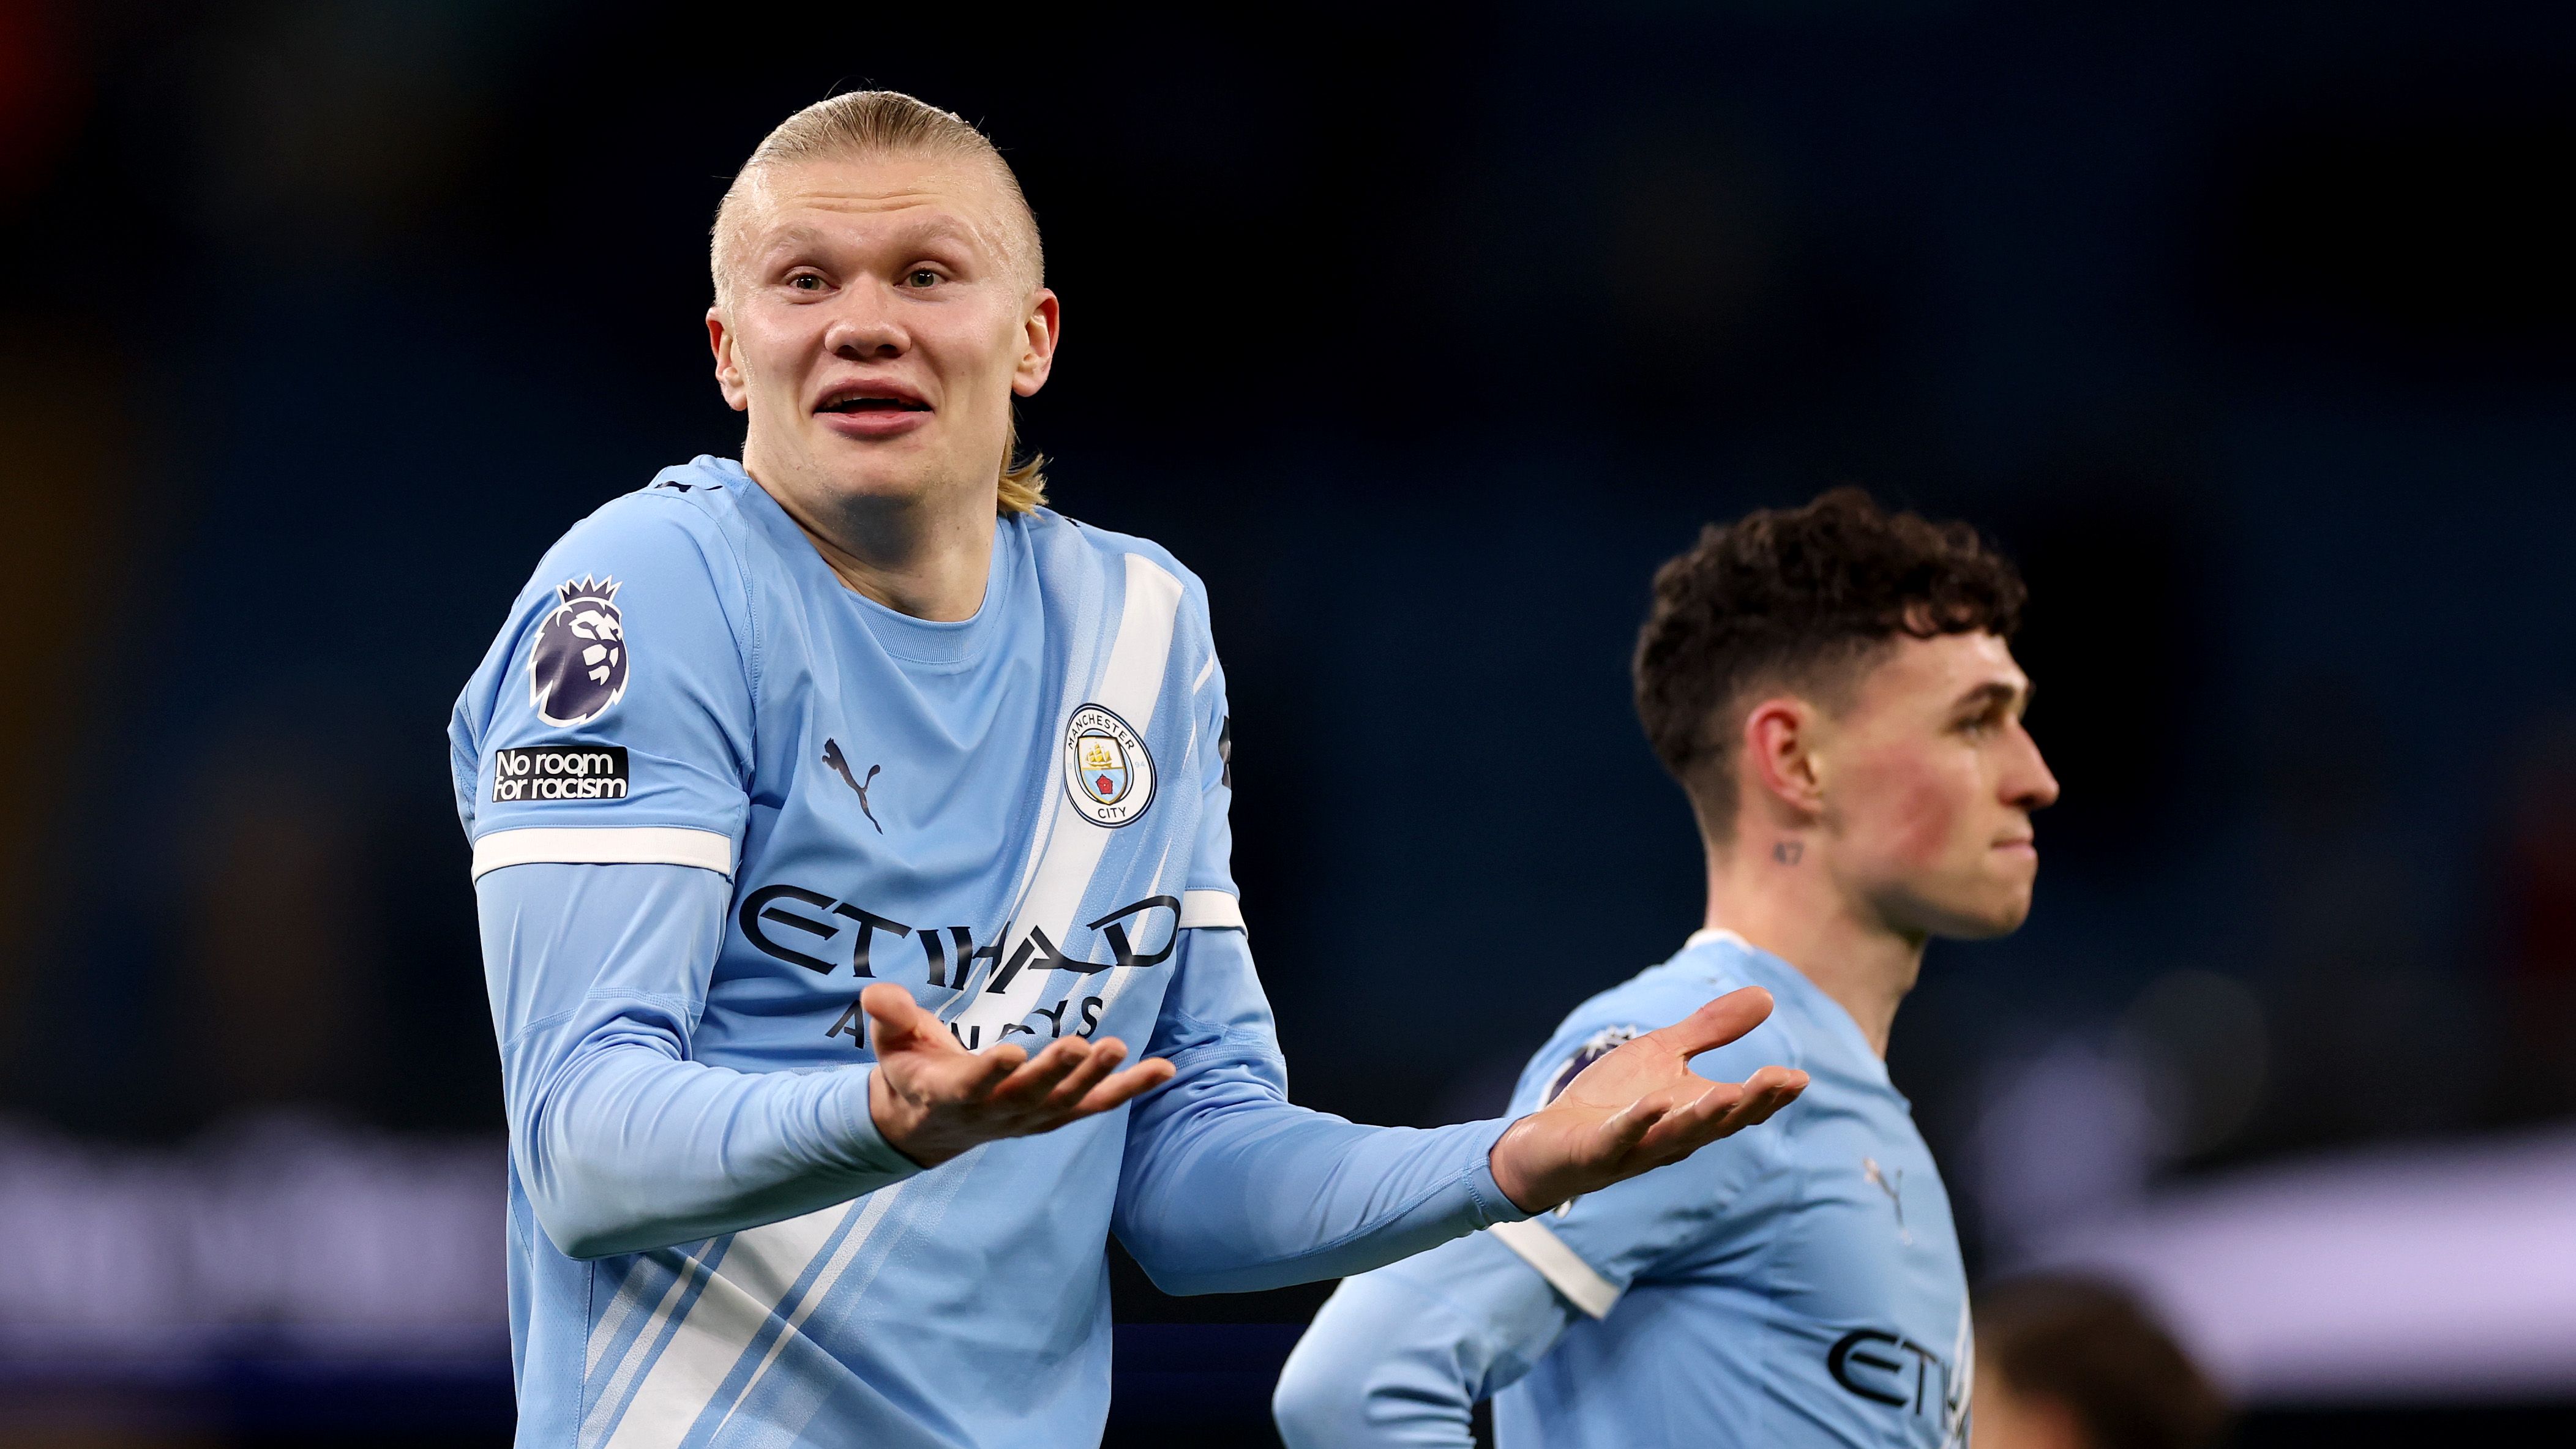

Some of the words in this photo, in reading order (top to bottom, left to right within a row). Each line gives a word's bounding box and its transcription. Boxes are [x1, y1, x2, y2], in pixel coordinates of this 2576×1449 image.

[1068, 713, 1135, 751] MANCHESTER
[496, 750, 531, 777] No
[534, 753, 613, 775] room
[493, 776, 528, 801] for
[531, 770, 627, 799] racism
[1097, 806, 1126, 819] CITY
[738, 883, 1181, 994] ETIHAD
